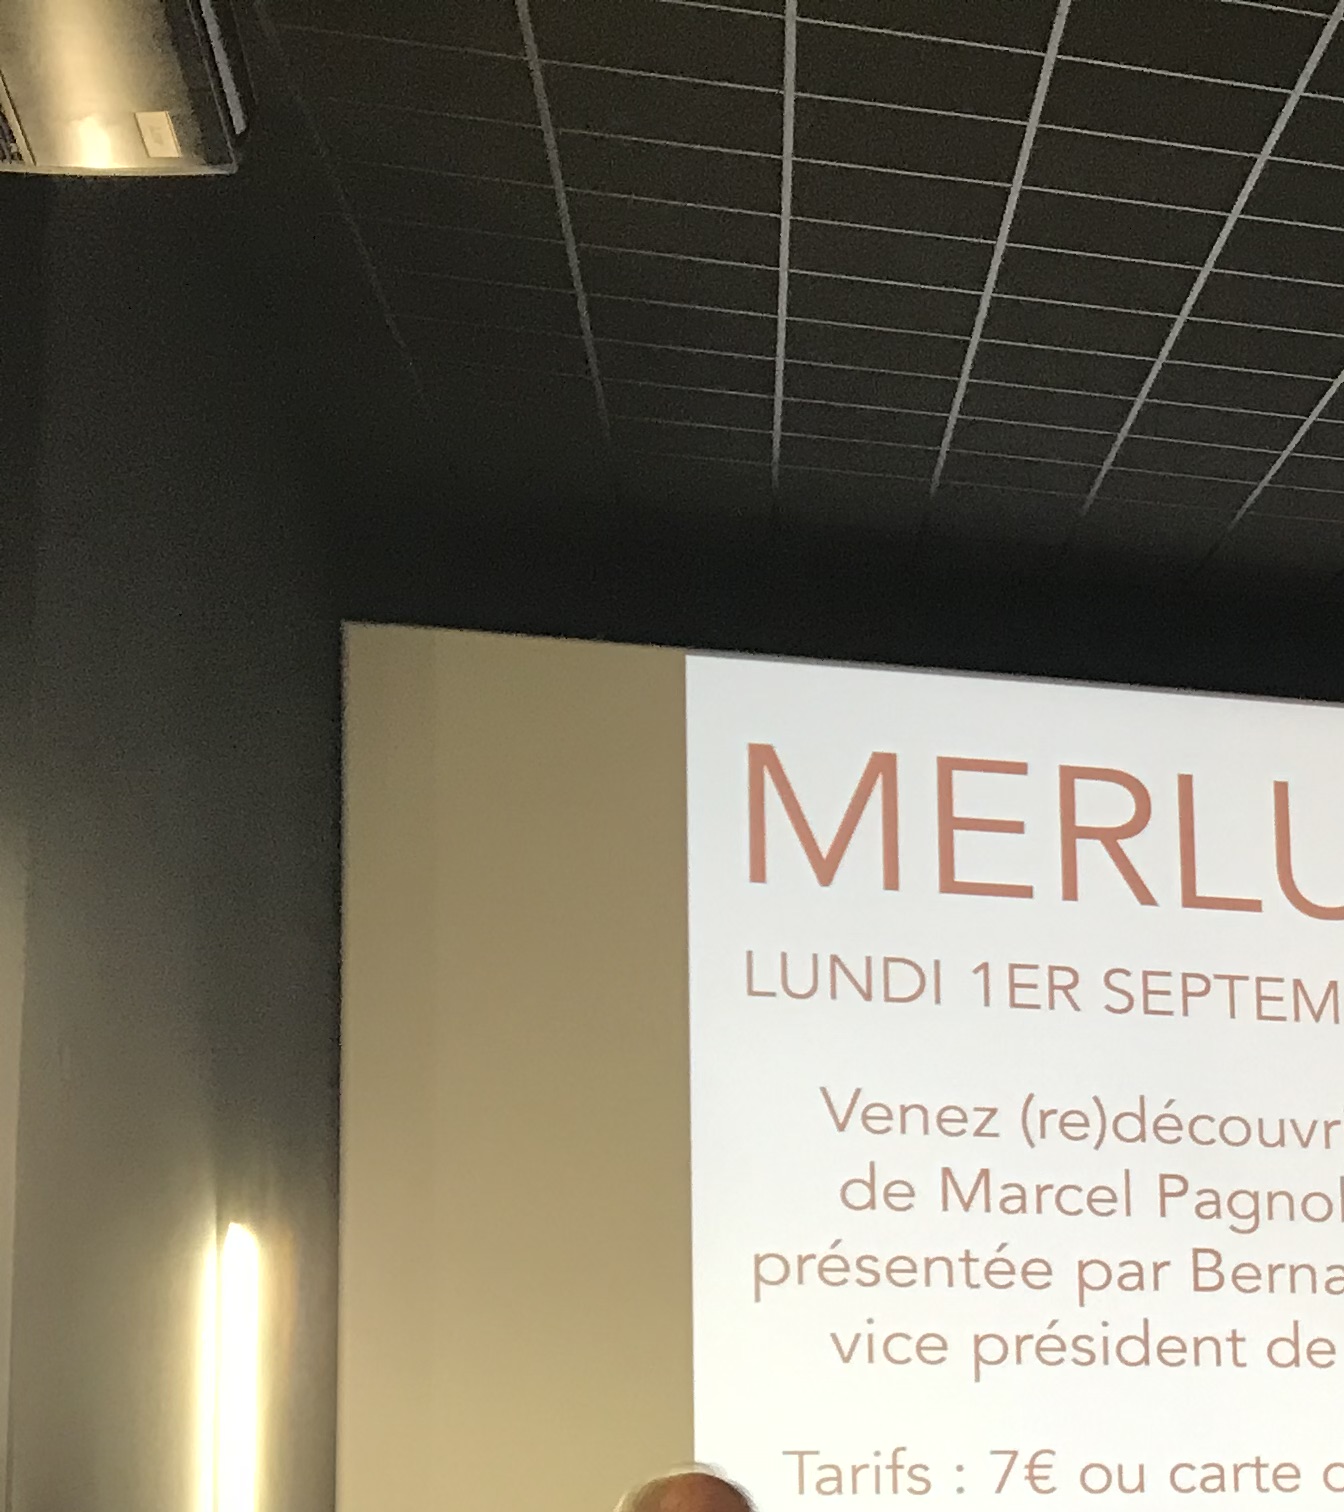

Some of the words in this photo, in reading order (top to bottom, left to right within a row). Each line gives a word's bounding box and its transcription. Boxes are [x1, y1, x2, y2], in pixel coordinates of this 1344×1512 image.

[745, 949, 942, 1006] LUNDI
[971, 960, 1082, 1013] 1ER
[819, 1085, 1001, 1139] Venez
[839, 1160, 917, 1213] de
[940, 1165, 1132, 1218] Marcel
[753, 1238, 1054, 1304] présentée
[1076, 1257, 1172, 1309] par
[829, 1317, 949, 1366] vice
[972, 1316, 1248, 1384] président
[1266, 1319, 1337, 1370] de
[781, 1445, 933, 1497] Tarifs
[955, 1463, 966, 1495] :
[989, 1448, 1058, 1496] 7€
[1078, 1461, 1146, 1495] ou
[1168, 1455, 1302, 1495] carte
